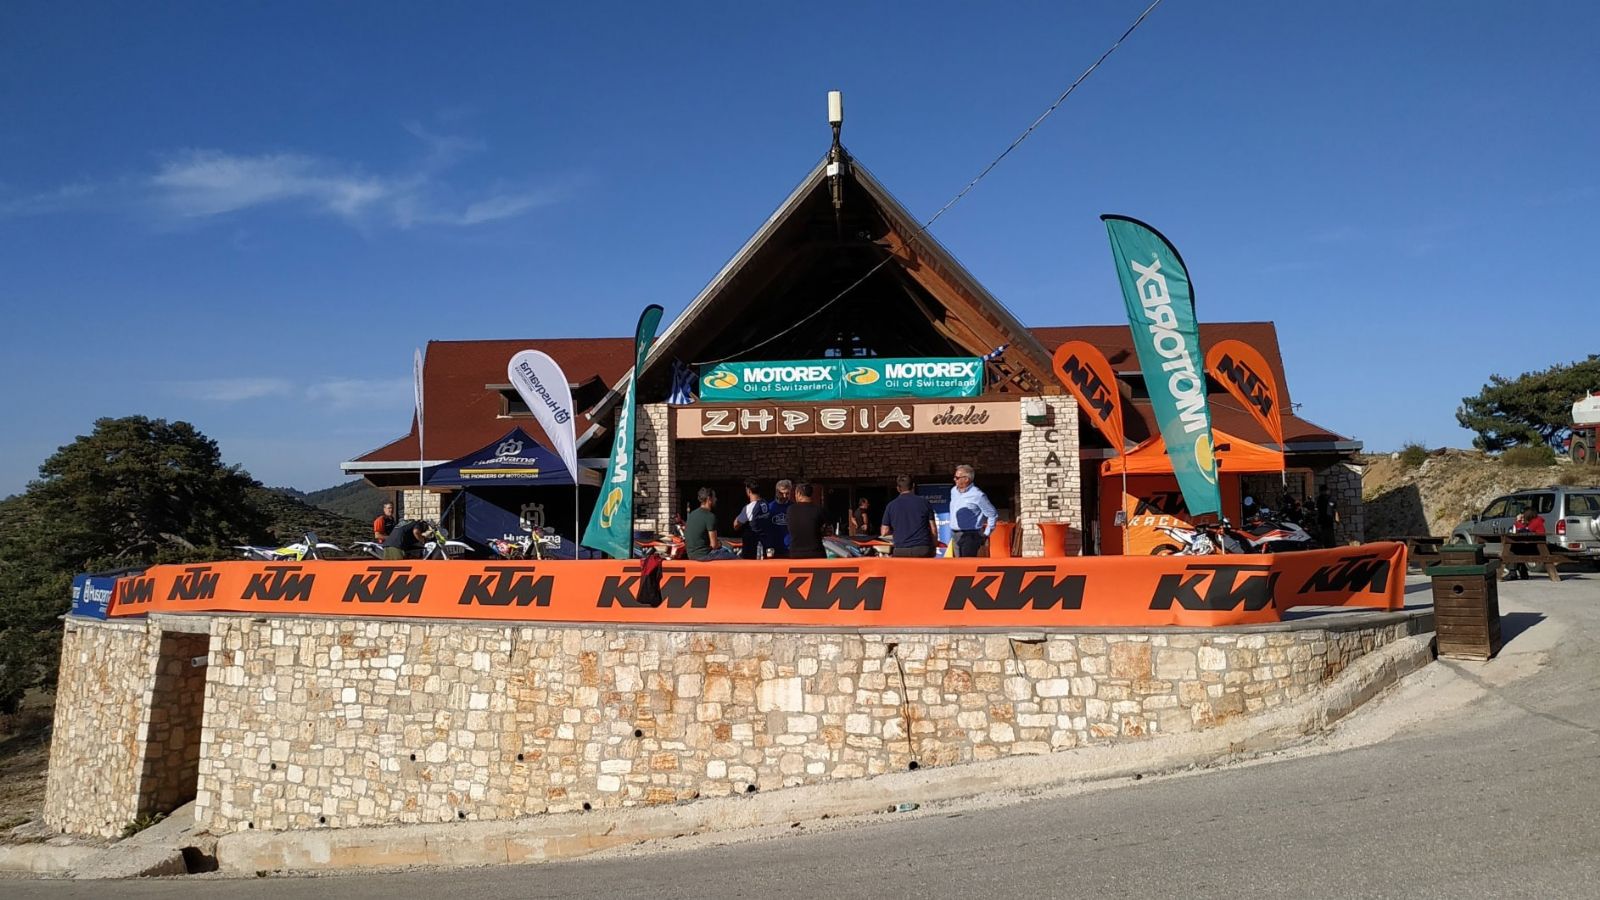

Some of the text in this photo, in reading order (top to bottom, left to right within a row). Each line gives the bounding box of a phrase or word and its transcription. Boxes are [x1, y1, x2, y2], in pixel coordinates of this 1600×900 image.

[743, 366, 833, 383] MOTOREX
[885, 362, 975, 379] MOTOREX
[743, 382, 834, 392] Oil of Switzerland
[885, 379, 976, 388] Oil of Switzerland
[932, 405, 990, 426] chalet
[473, 456, 537, 466] Husqvarna
[1044, 429, 1061, 510] CAFE
[1128, 515, 1187, 526] RACI
[167, 566, 220, 600] KTM
[240, 565, 316, 602] KTM
[341, 566, 428, 604] KTM
[458, 566, 555, 607] KTM
[761, 567, 887, 611] KTM
[943, 565, 1088, 610] KTM
[1297, 553, 1391, 594] KTM
